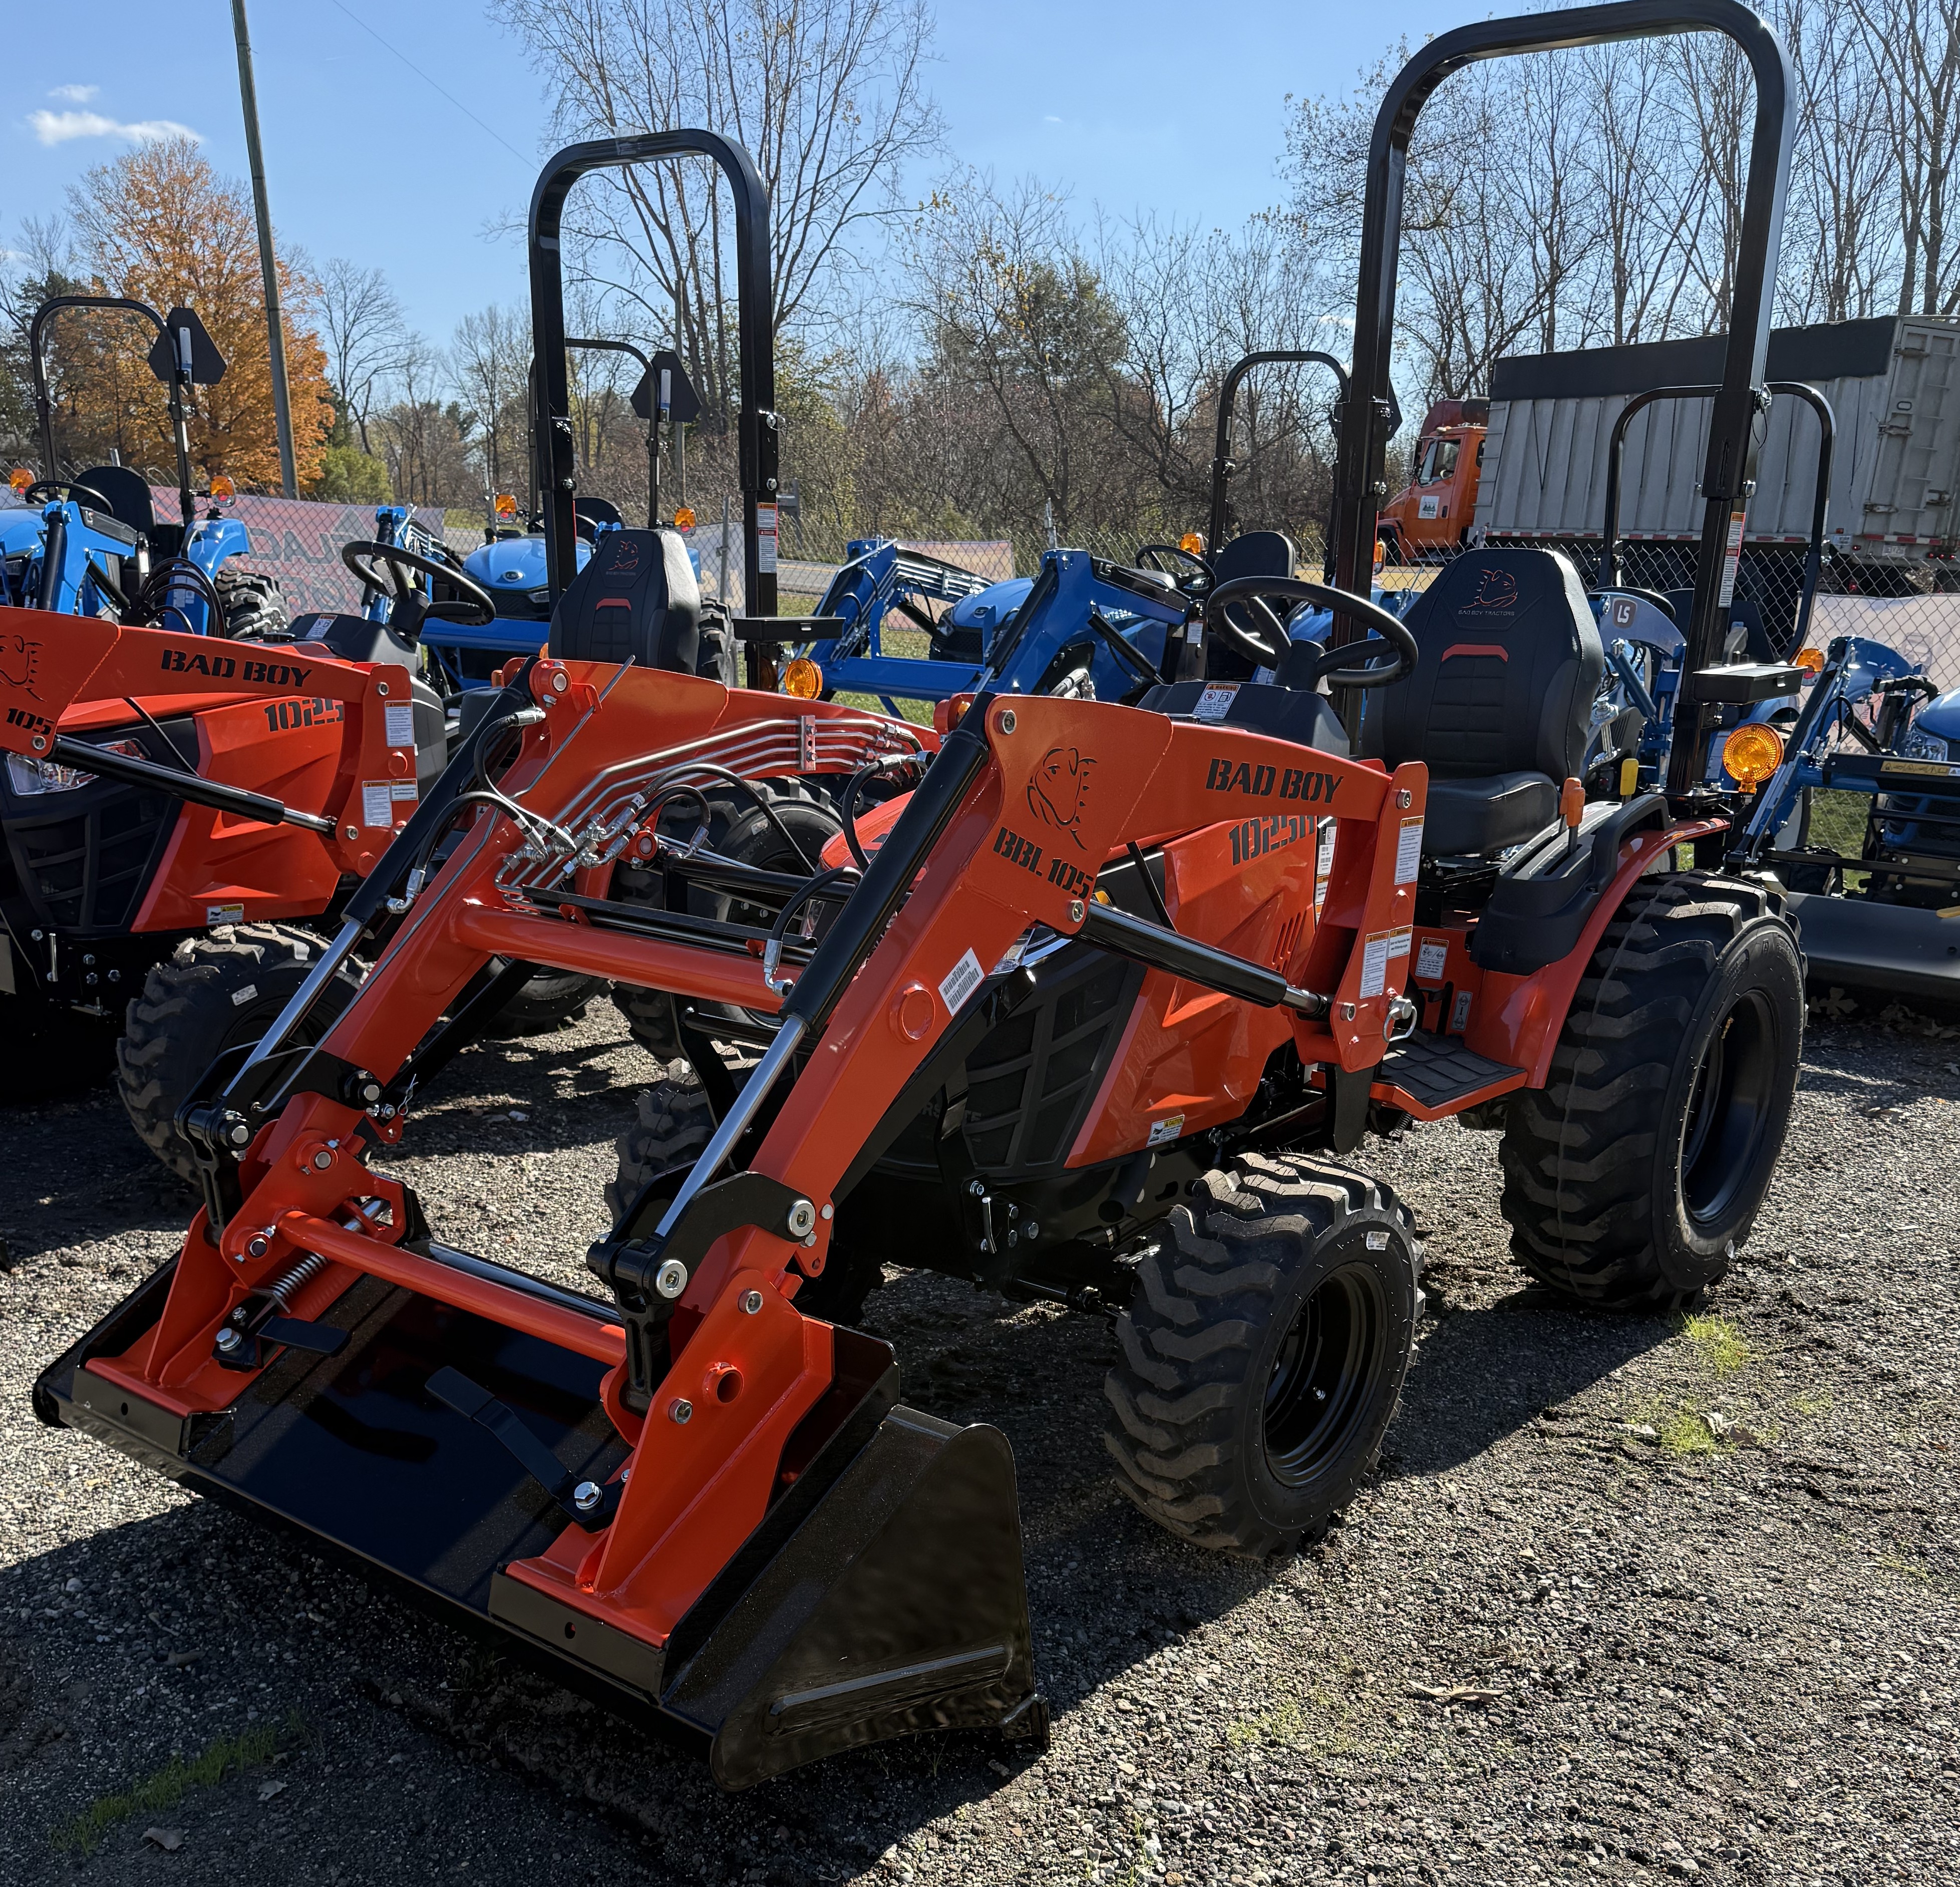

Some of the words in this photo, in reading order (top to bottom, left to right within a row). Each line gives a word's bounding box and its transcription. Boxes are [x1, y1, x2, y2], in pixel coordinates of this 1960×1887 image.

[1617, 605, 1630, 623] LS
[161, 649, 236, 678] BAD
[242, 661, 312, 688] BOY
[7, 708, 55, 735] 105
[1206, 758, 1276, 796] BAD
[1279, 768, 1344, 803] BOY
[993, 826, 1044, 876] BBL
[1048, 858, 1094, 899] 105
